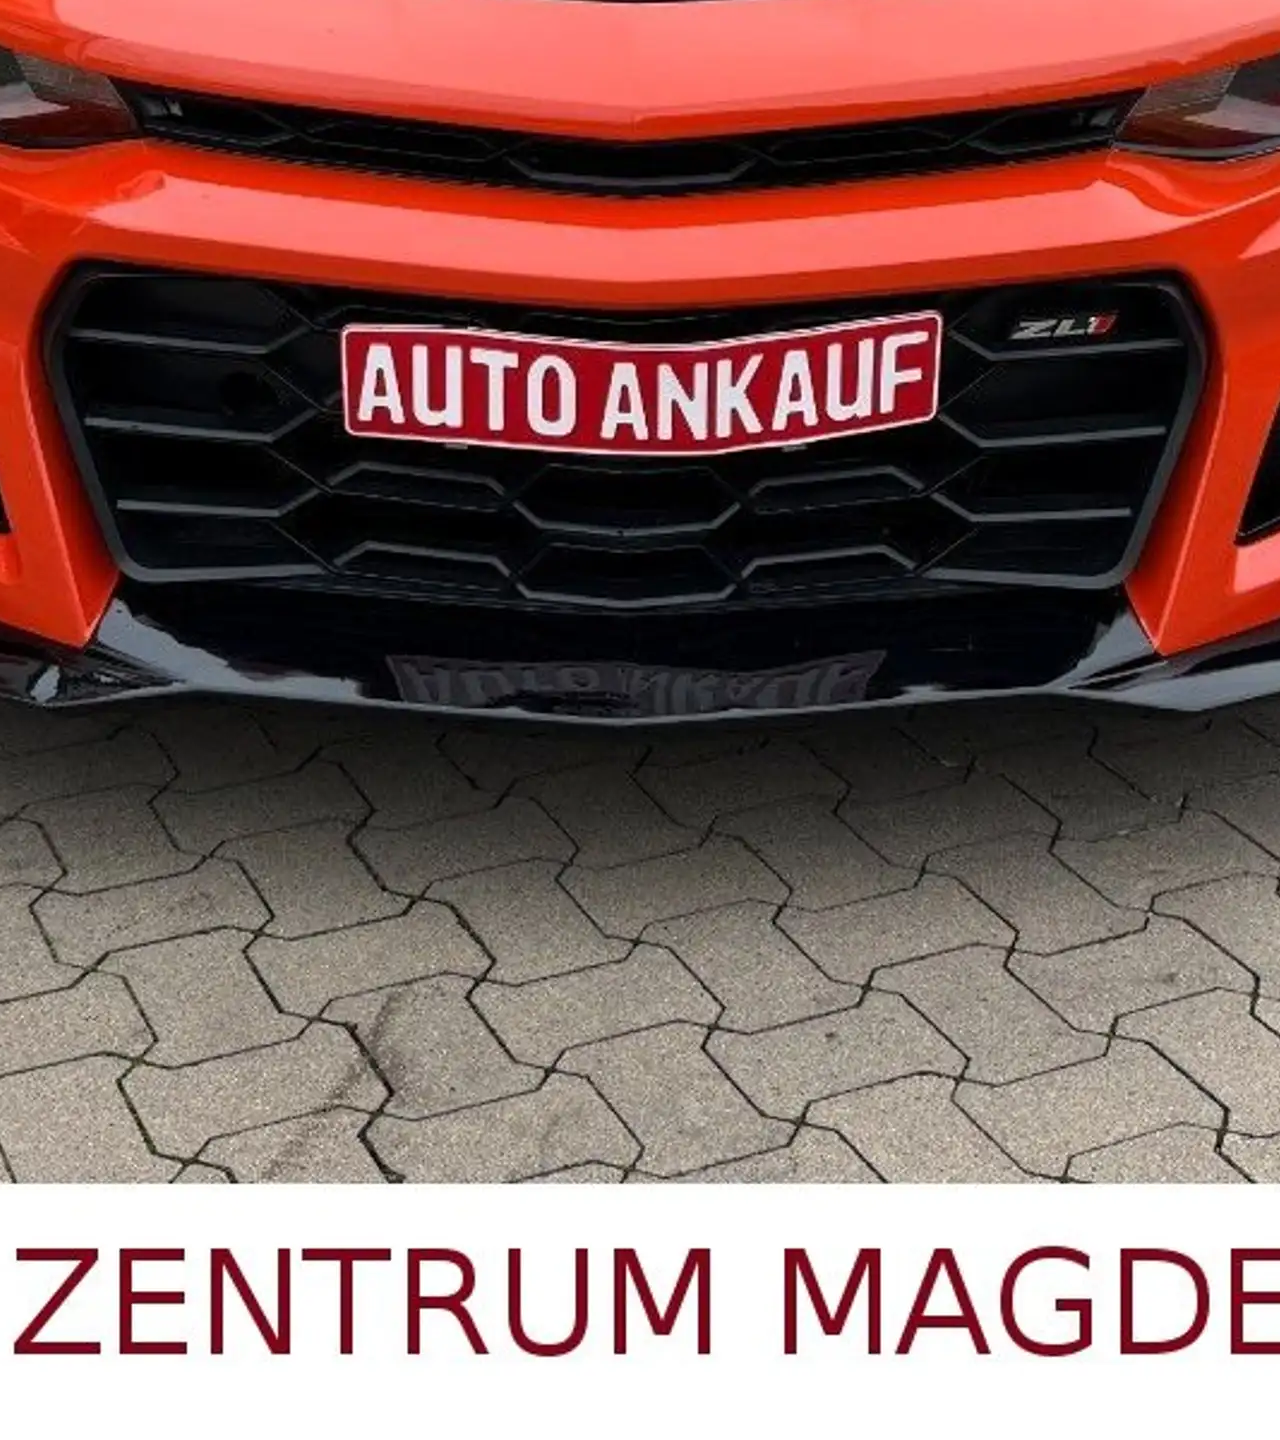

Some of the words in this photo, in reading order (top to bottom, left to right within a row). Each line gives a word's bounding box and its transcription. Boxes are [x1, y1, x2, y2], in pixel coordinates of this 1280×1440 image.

[1009, 311, 1118, 341] ZL1
[357, 344, 577, 436] AUTO
[599, 331, 930, 441] ANKAUF
